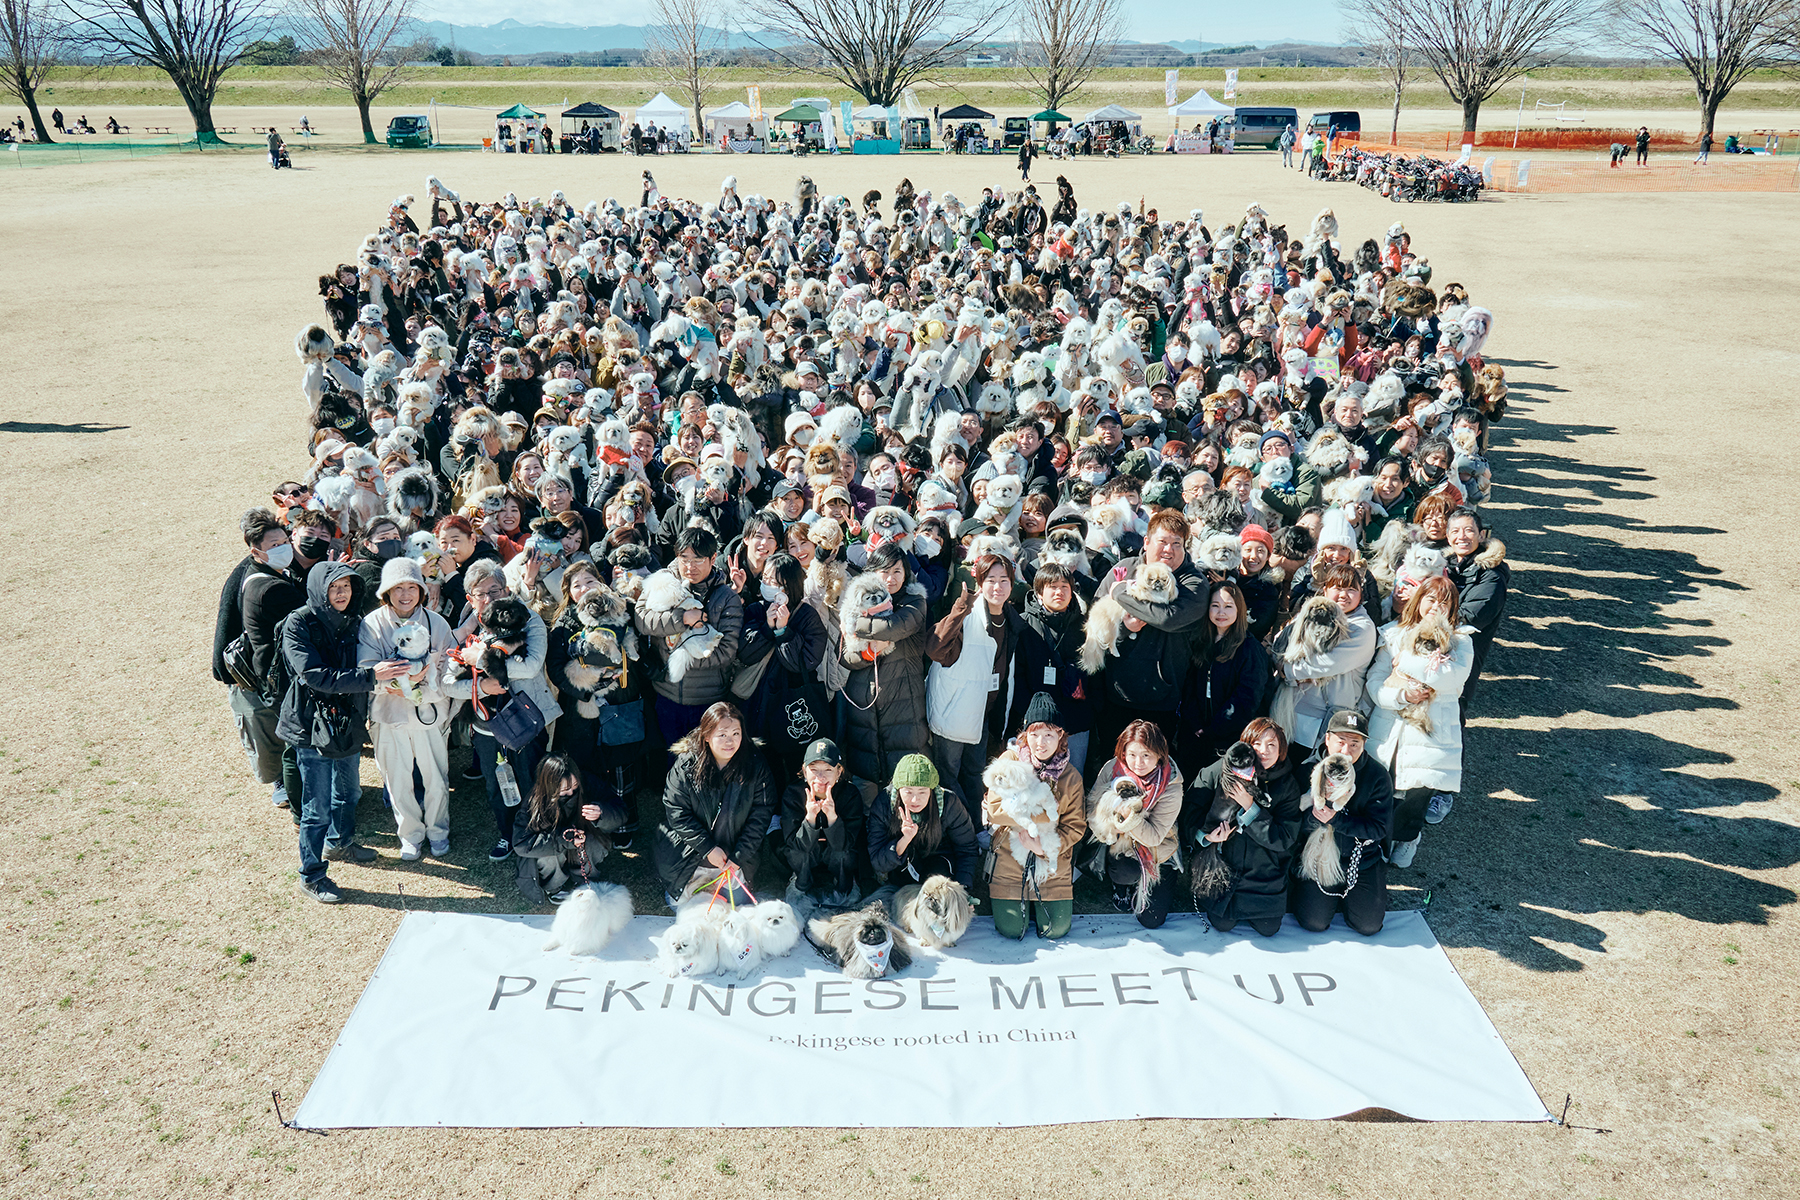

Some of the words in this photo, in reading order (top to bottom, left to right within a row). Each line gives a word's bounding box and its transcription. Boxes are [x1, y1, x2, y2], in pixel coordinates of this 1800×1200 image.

[1347, 716, 1357, 726] M
[488, 974, 959, 1017] PEKINGESE
[989, 966, 1204, 1010] MEET
[1233, 972, 1337, 1007] UP
[893, 1030, 970, 1047] rooted
[977, 1030, 1000, 1044] in
[1007, 1028, 1077, 1043] China
